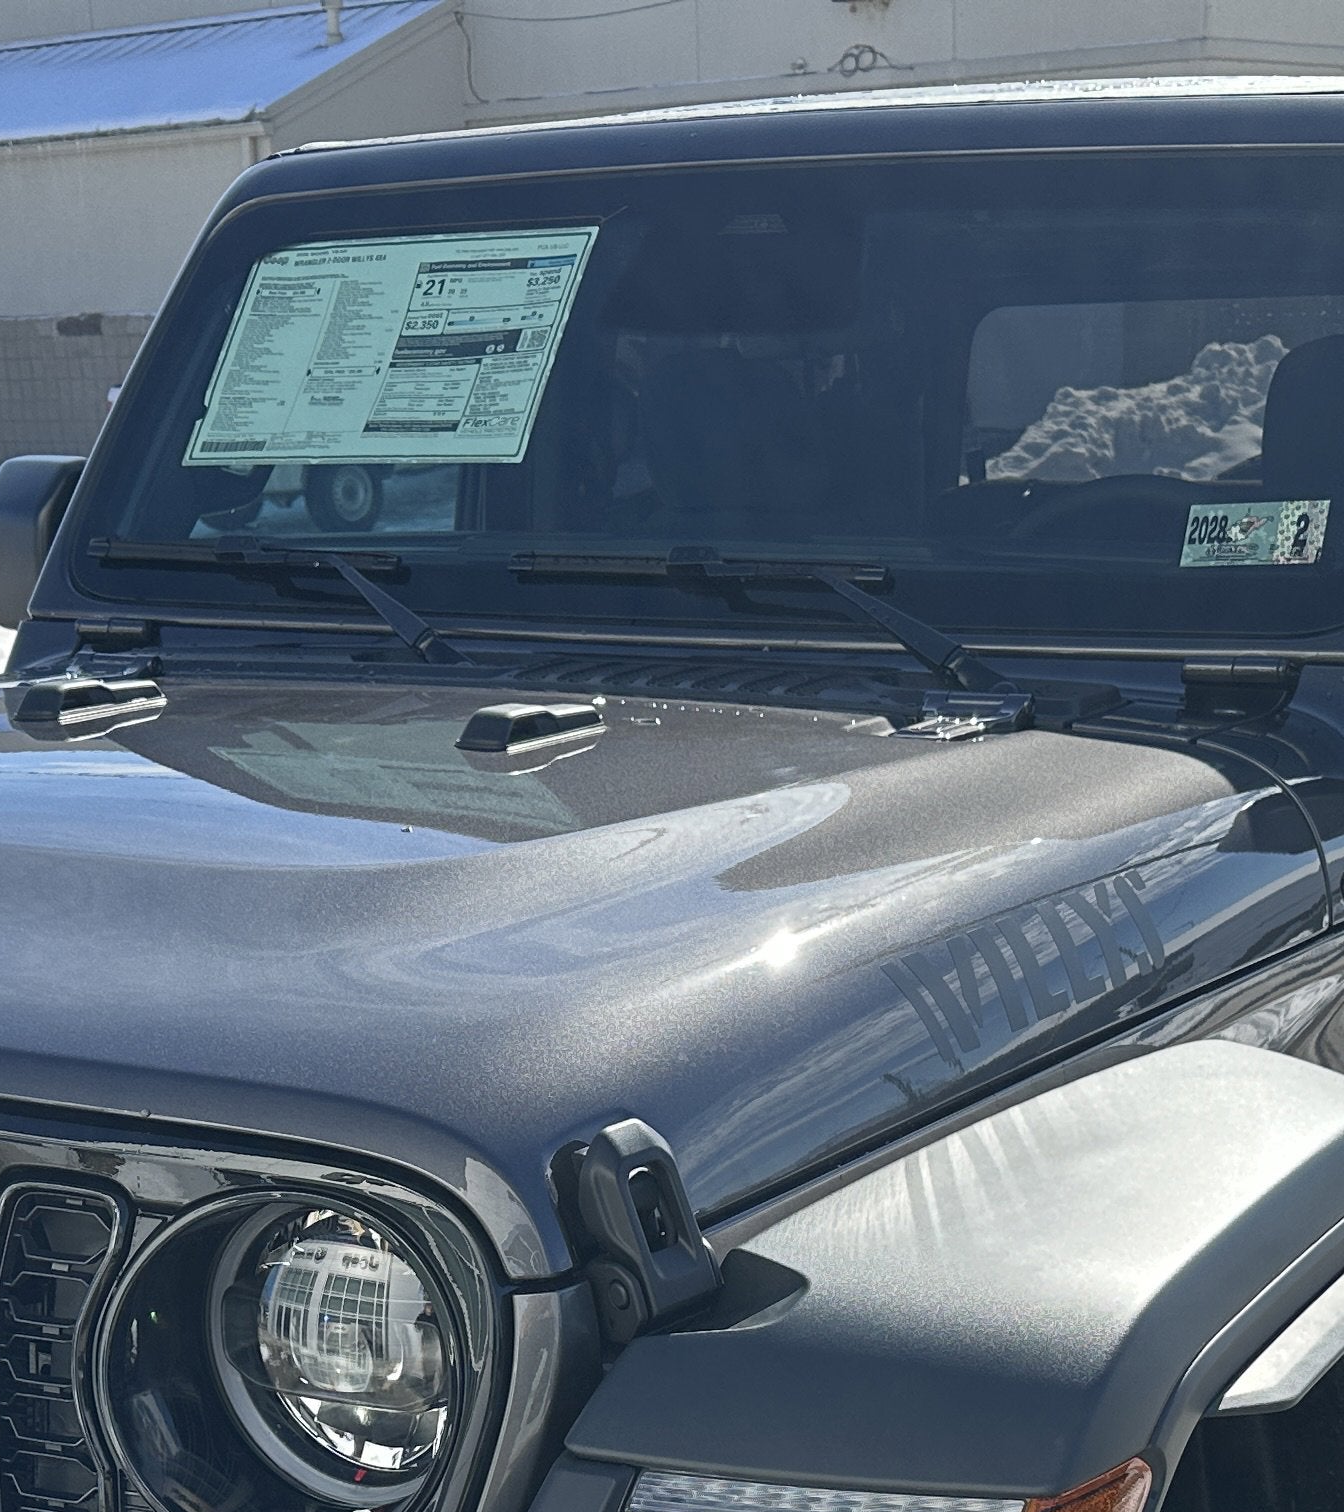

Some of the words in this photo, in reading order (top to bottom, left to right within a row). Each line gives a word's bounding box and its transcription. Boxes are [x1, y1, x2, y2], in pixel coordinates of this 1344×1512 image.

[422, 278, 446, 296] 21
[462, 415, 521, 428] FlexCare
[1188, 515, 1229, 545] 2028
[1292, 512, 1310, 554] 2
[880, 869, 1164, 1063] WILLYS
